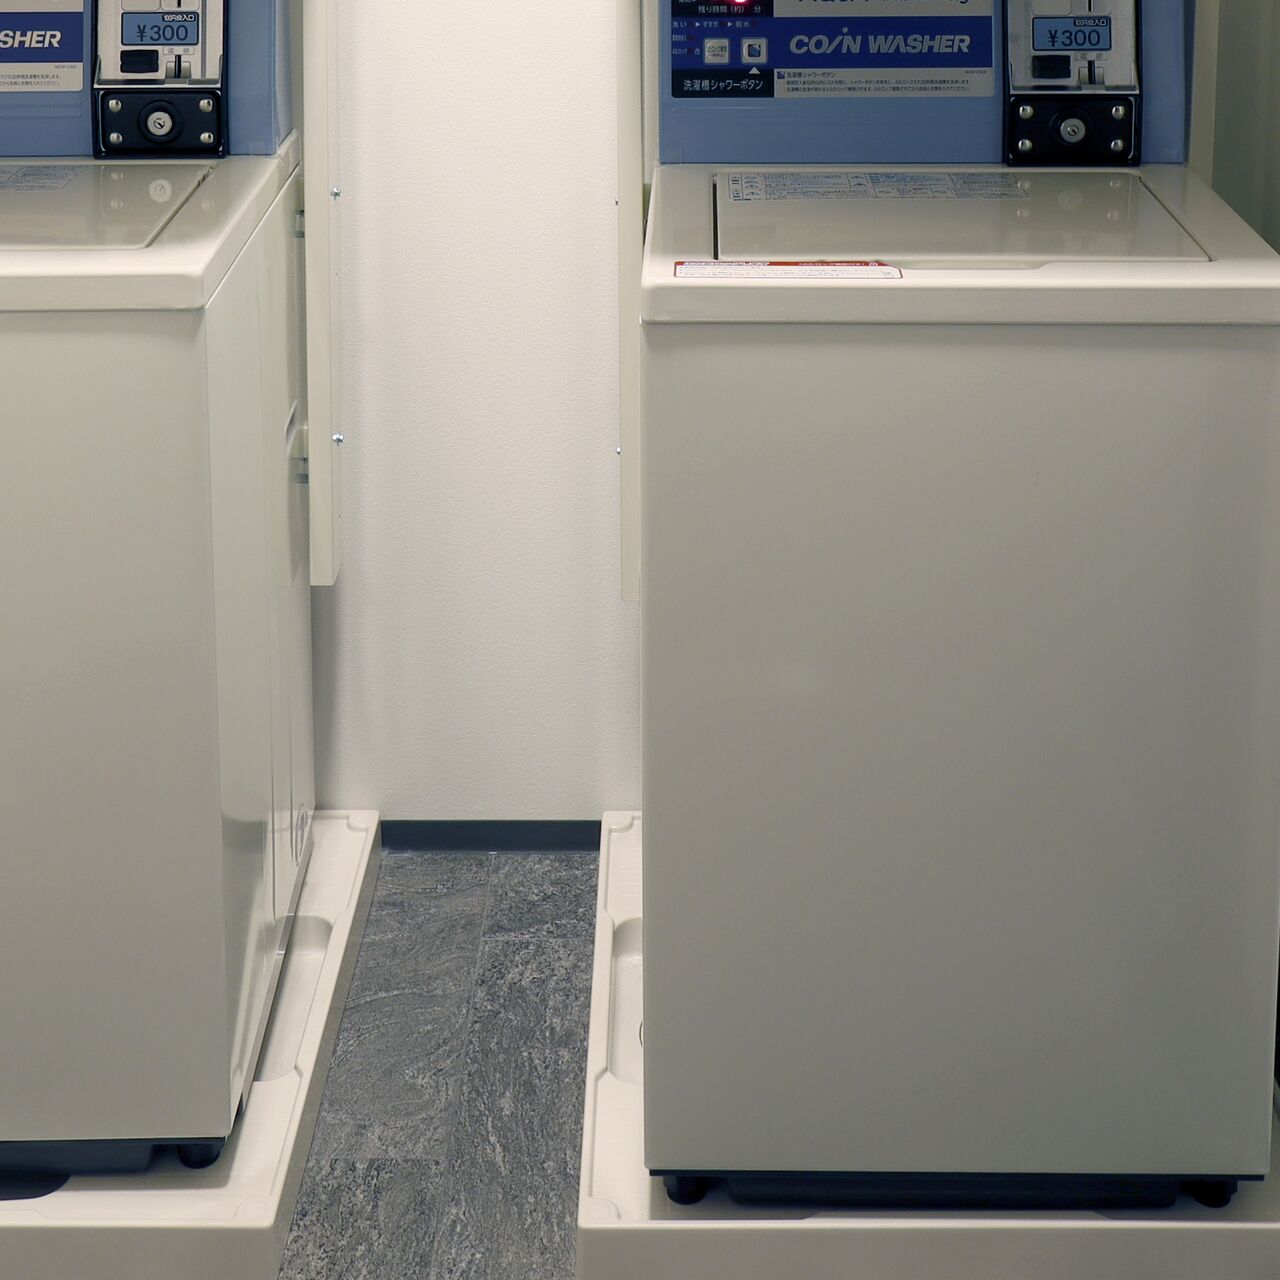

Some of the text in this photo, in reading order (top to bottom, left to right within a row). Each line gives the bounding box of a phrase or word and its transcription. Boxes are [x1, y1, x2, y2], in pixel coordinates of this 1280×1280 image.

[754, 5, 762, 13] 分
[136, 24, 188, 42] ¥300
[1048, 29, 1100, 48] ¥300
[868, 34, 971, 54] WASHER
